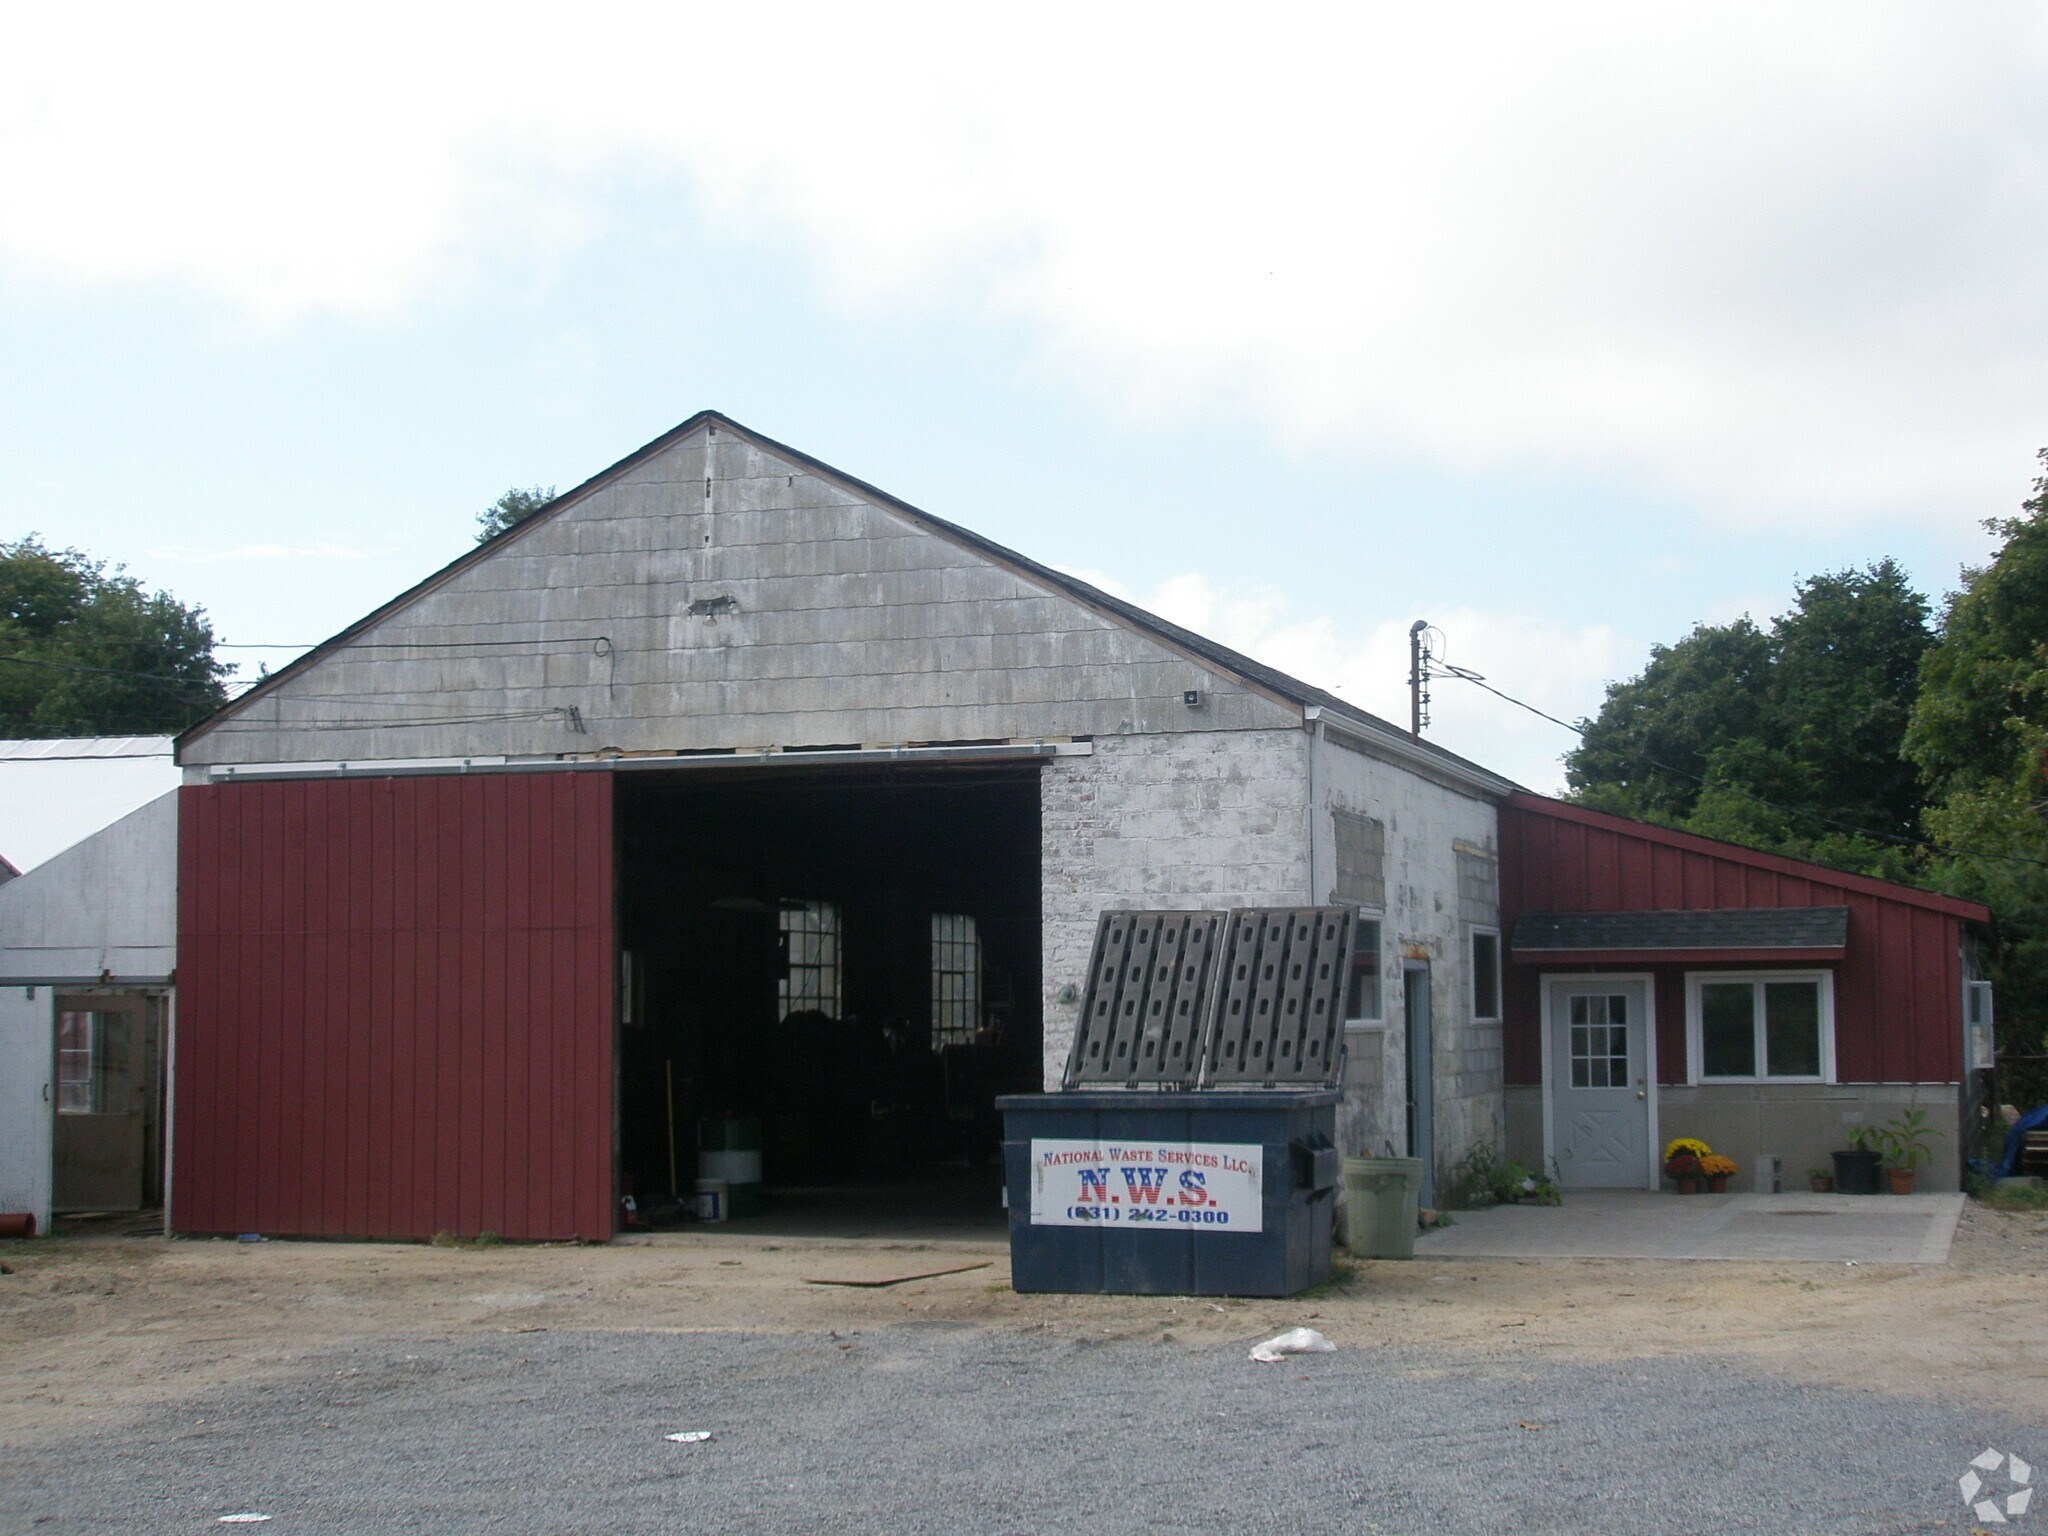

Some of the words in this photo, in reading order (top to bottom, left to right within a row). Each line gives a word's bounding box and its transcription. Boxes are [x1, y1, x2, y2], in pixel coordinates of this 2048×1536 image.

[1043, 1150, 1104, 1167] NATIONAL
[1108, 1147, 1153, 1162] WASTE
[1159, 1149, 1218, 1168] SERVICES
[1077, 1167, 1217, 1207] N.W.S.
